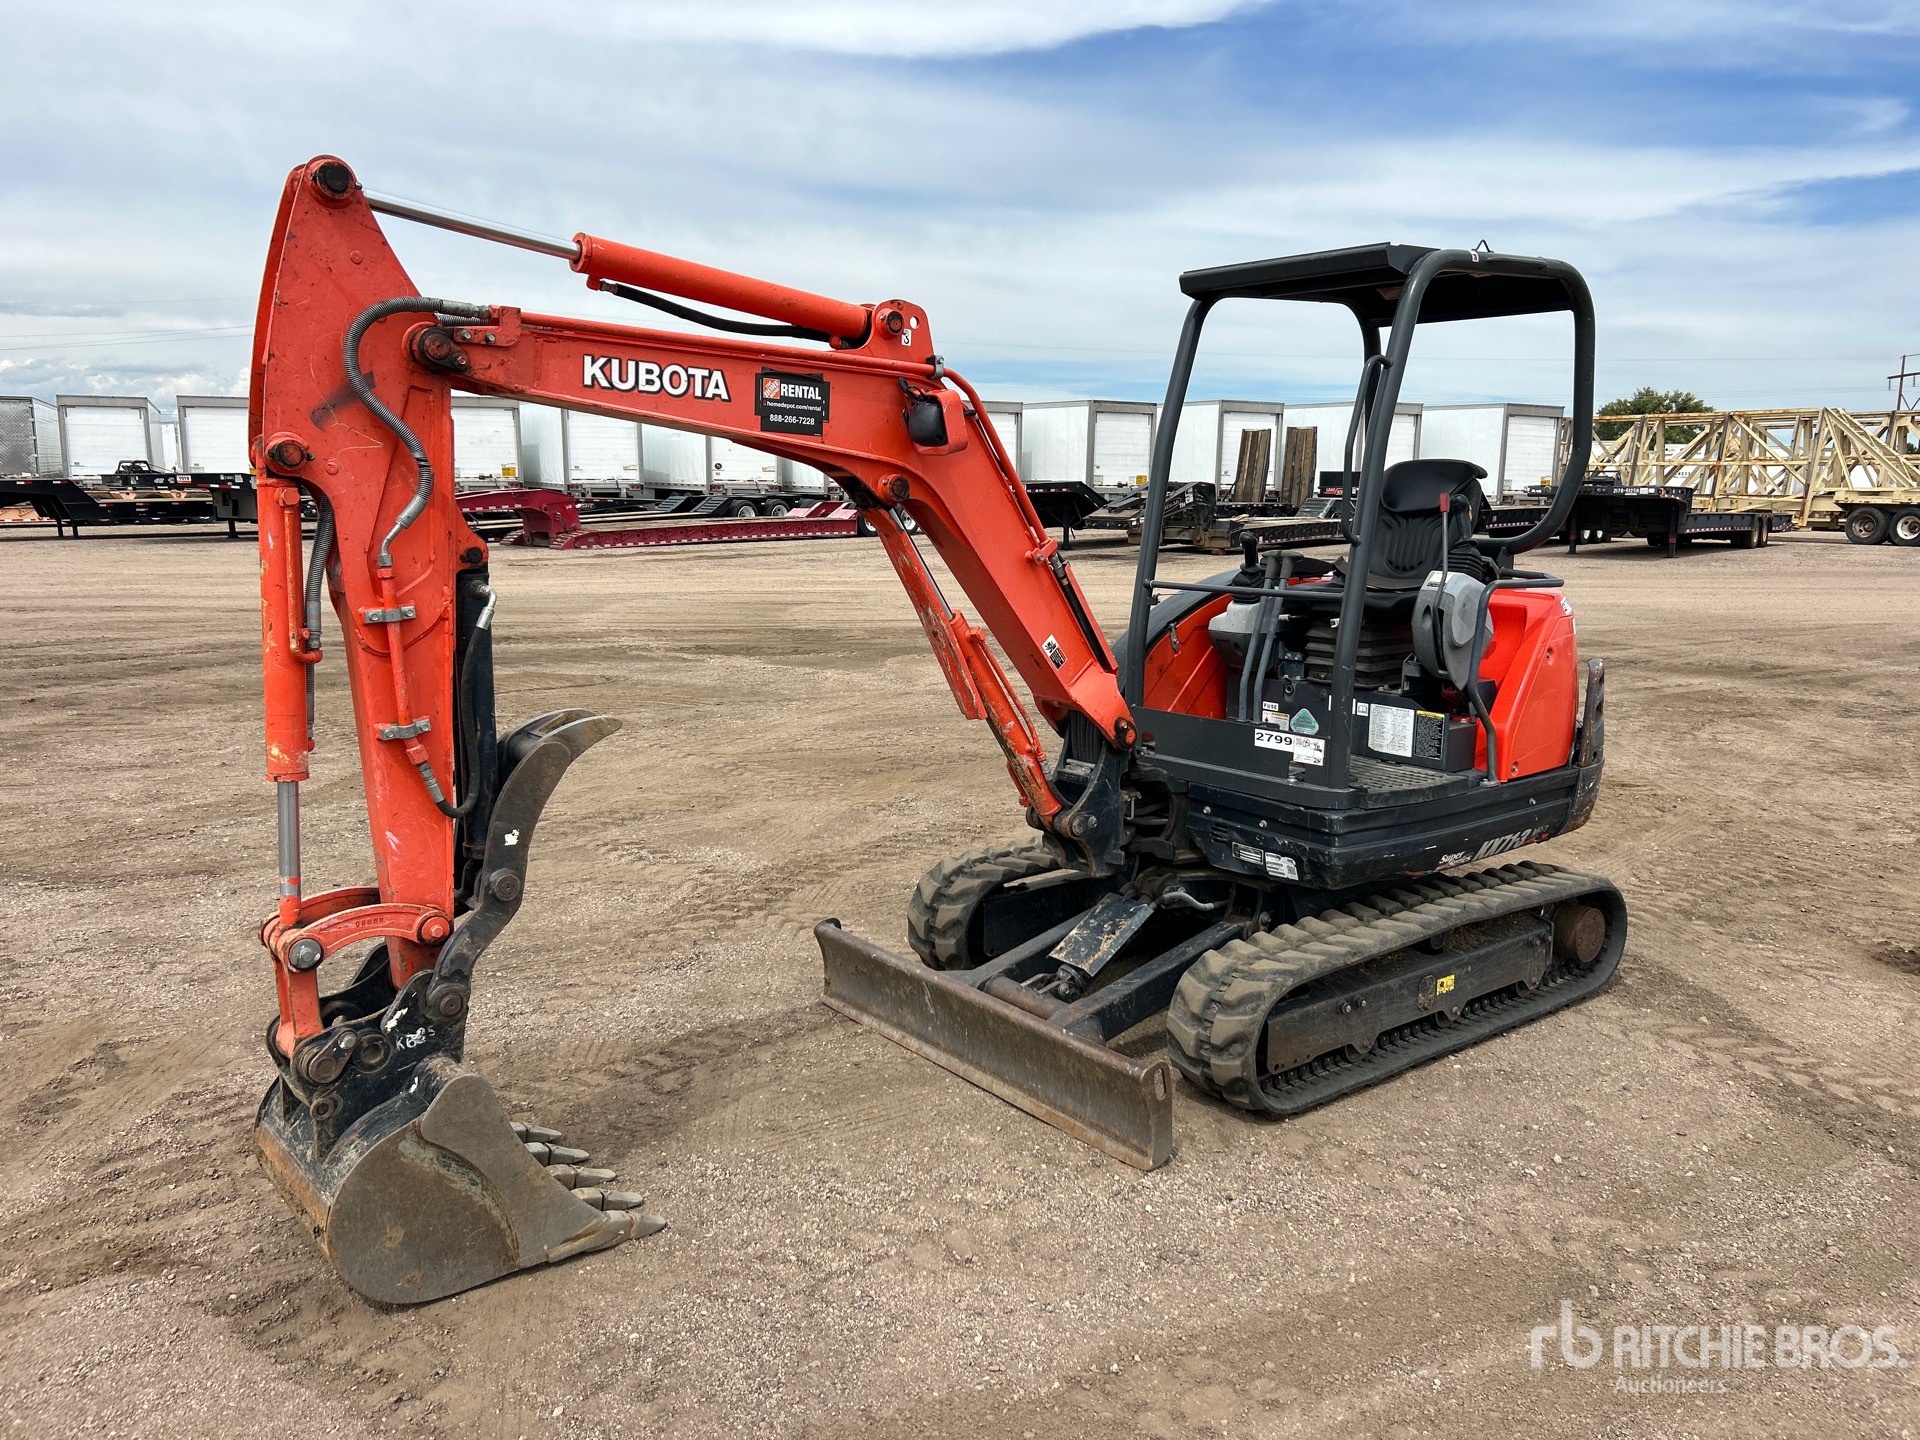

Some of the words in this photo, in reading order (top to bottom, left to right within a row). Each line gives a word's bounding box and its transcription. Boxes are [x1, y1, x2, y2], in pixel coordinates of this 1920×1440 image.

[583, 354, 731, 402] KUBOTA
[780, 383, 822, 400] RENTAL
[766, 400, 822, 412] homedepot.com/rental
[769, 413, 815, 426] 888-266-7228
[1263, 702, 1278, 710] FUSE
[1255, 731, 1293, 746] 2799
